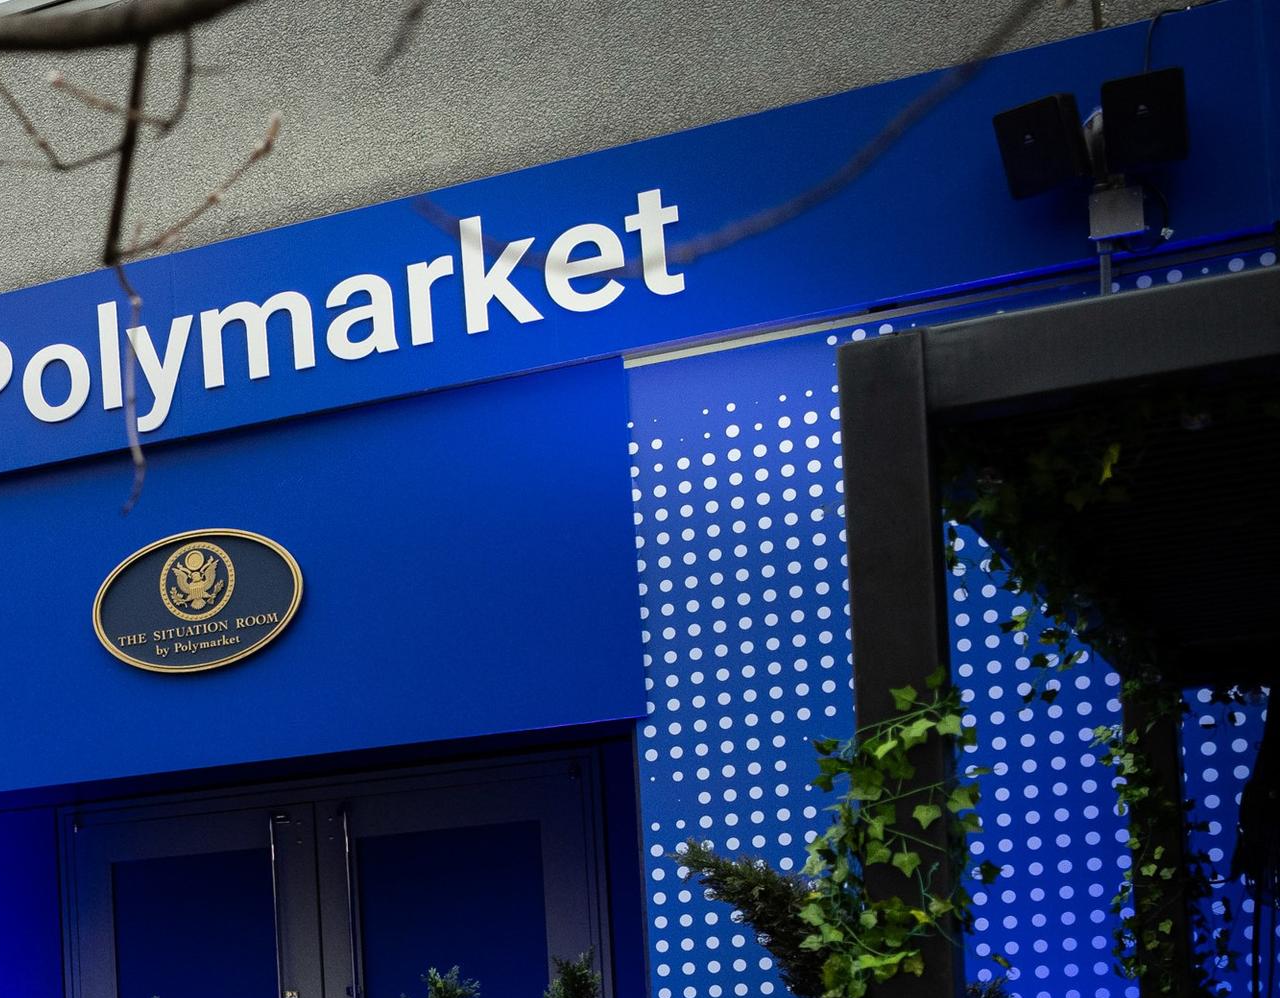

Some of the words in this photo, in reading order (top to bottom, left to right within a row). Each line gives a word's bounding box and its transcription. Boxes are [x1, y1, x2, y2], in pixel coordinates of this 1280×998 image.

[117, 632, 147, 648] THE
[153, 619, 228, 641] SITUATION
[236, 612, 279, 629] ROOM
[155, 645, 170, 657] by
[175, 634, 241, 653] Polymarket
